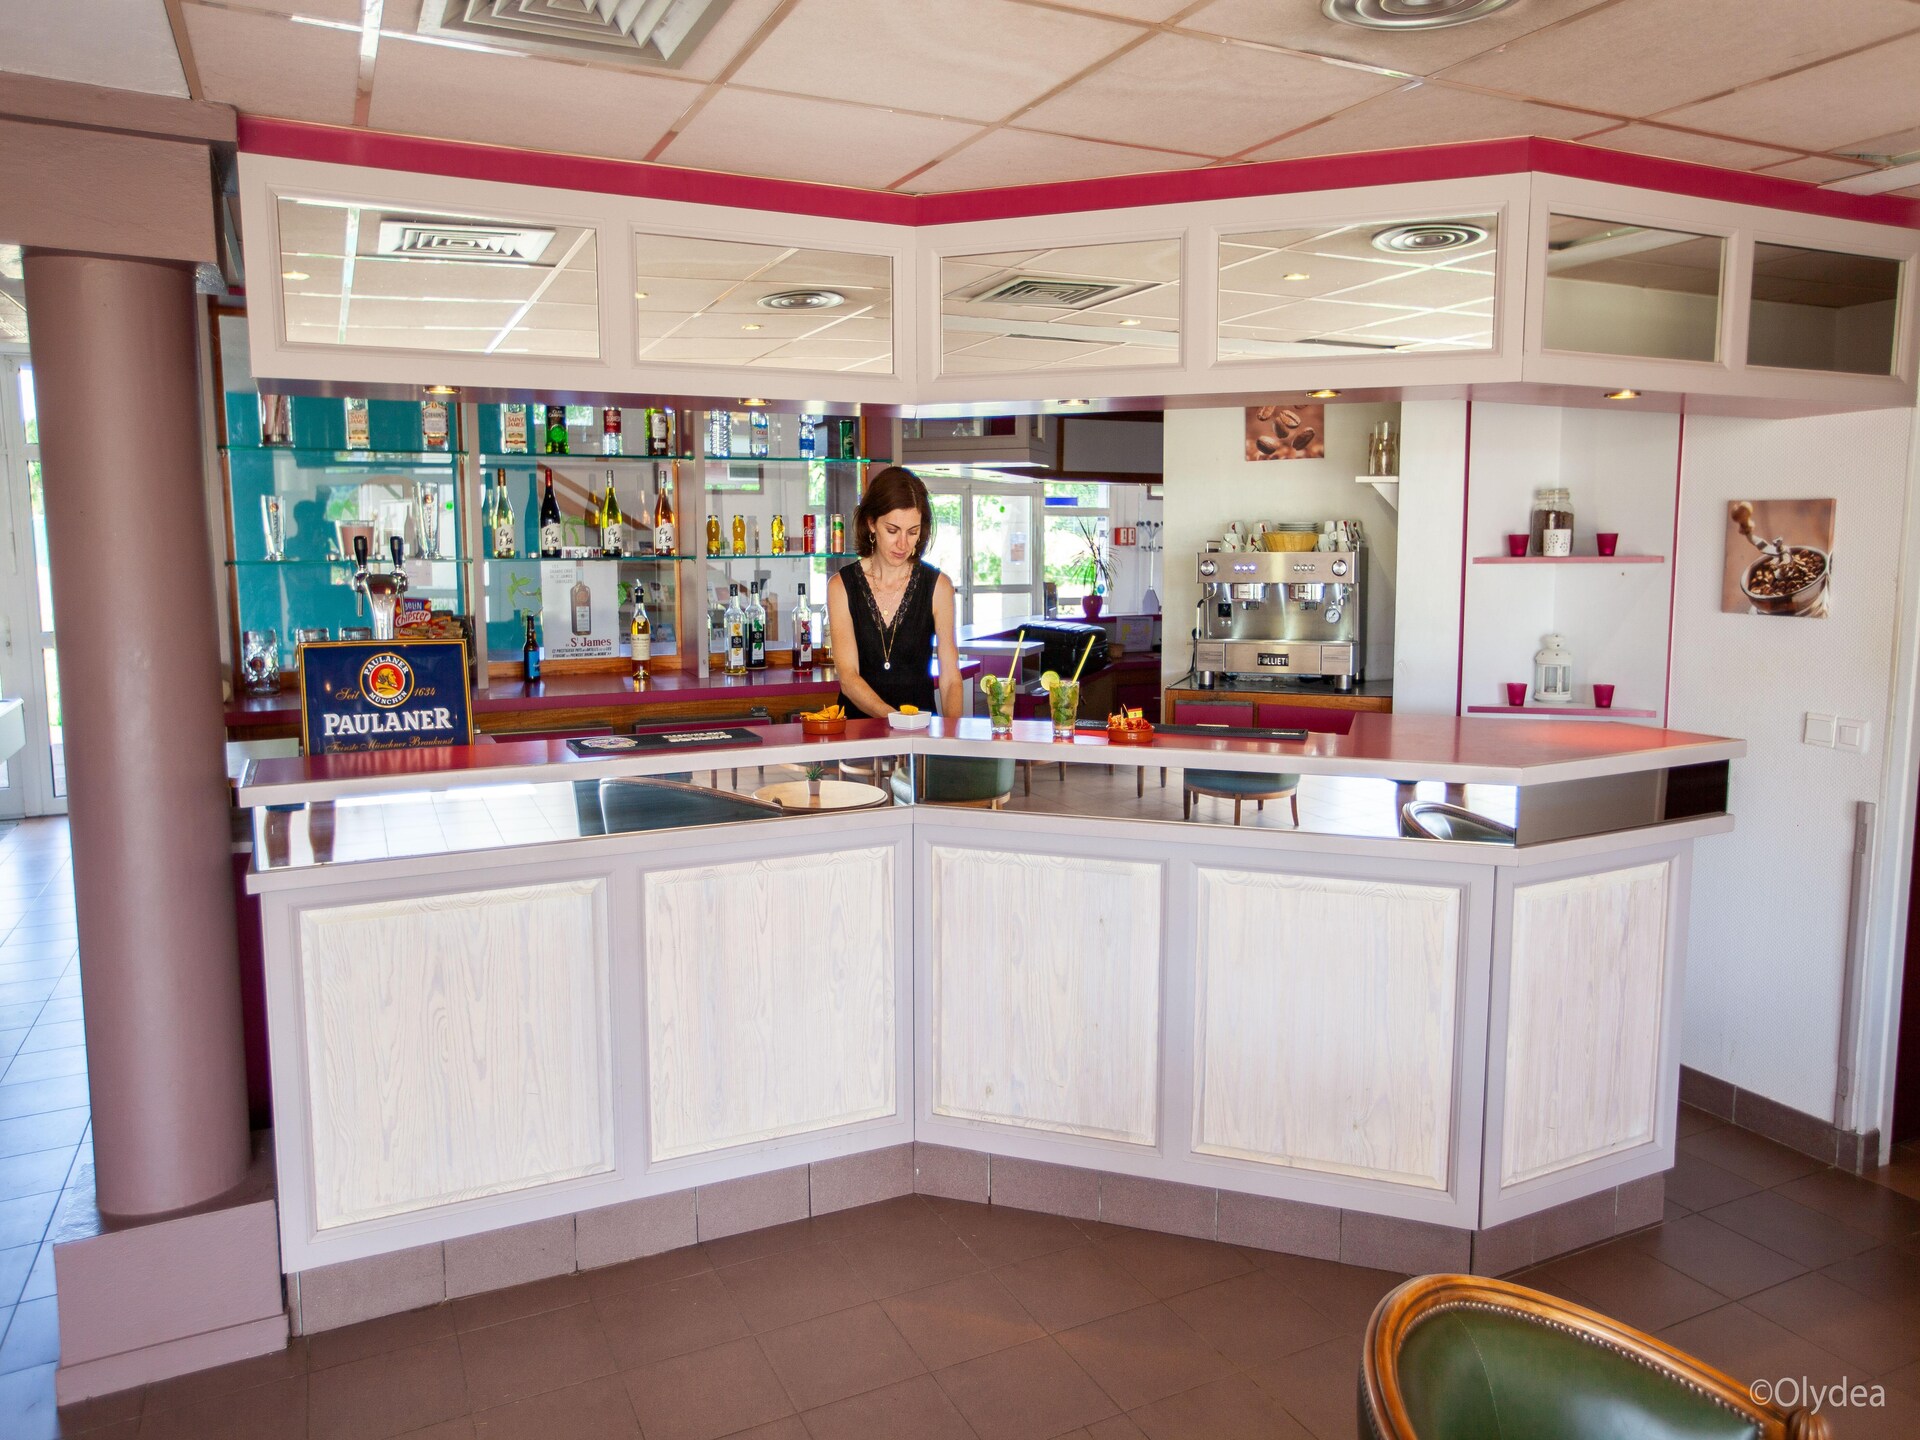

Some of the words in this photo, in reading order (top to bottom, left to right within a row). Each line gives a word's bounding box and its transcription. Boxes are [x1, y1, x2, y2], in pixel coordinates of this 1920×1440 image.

[581, 637, 612, 648] James
[364, 655, 409, 676] PAULANER
[335, 687, 360, 701] Seit
[368, 691, 408, 705] MÜNCHEN
[414, 687, 437, 697] 1634
[323, 707, 453, 736] PAULANER
[326, 740, 359, 753] Feinste
[360, 737, 406, 751] Münchner
[408, 736, 455, 747] Braukunst
